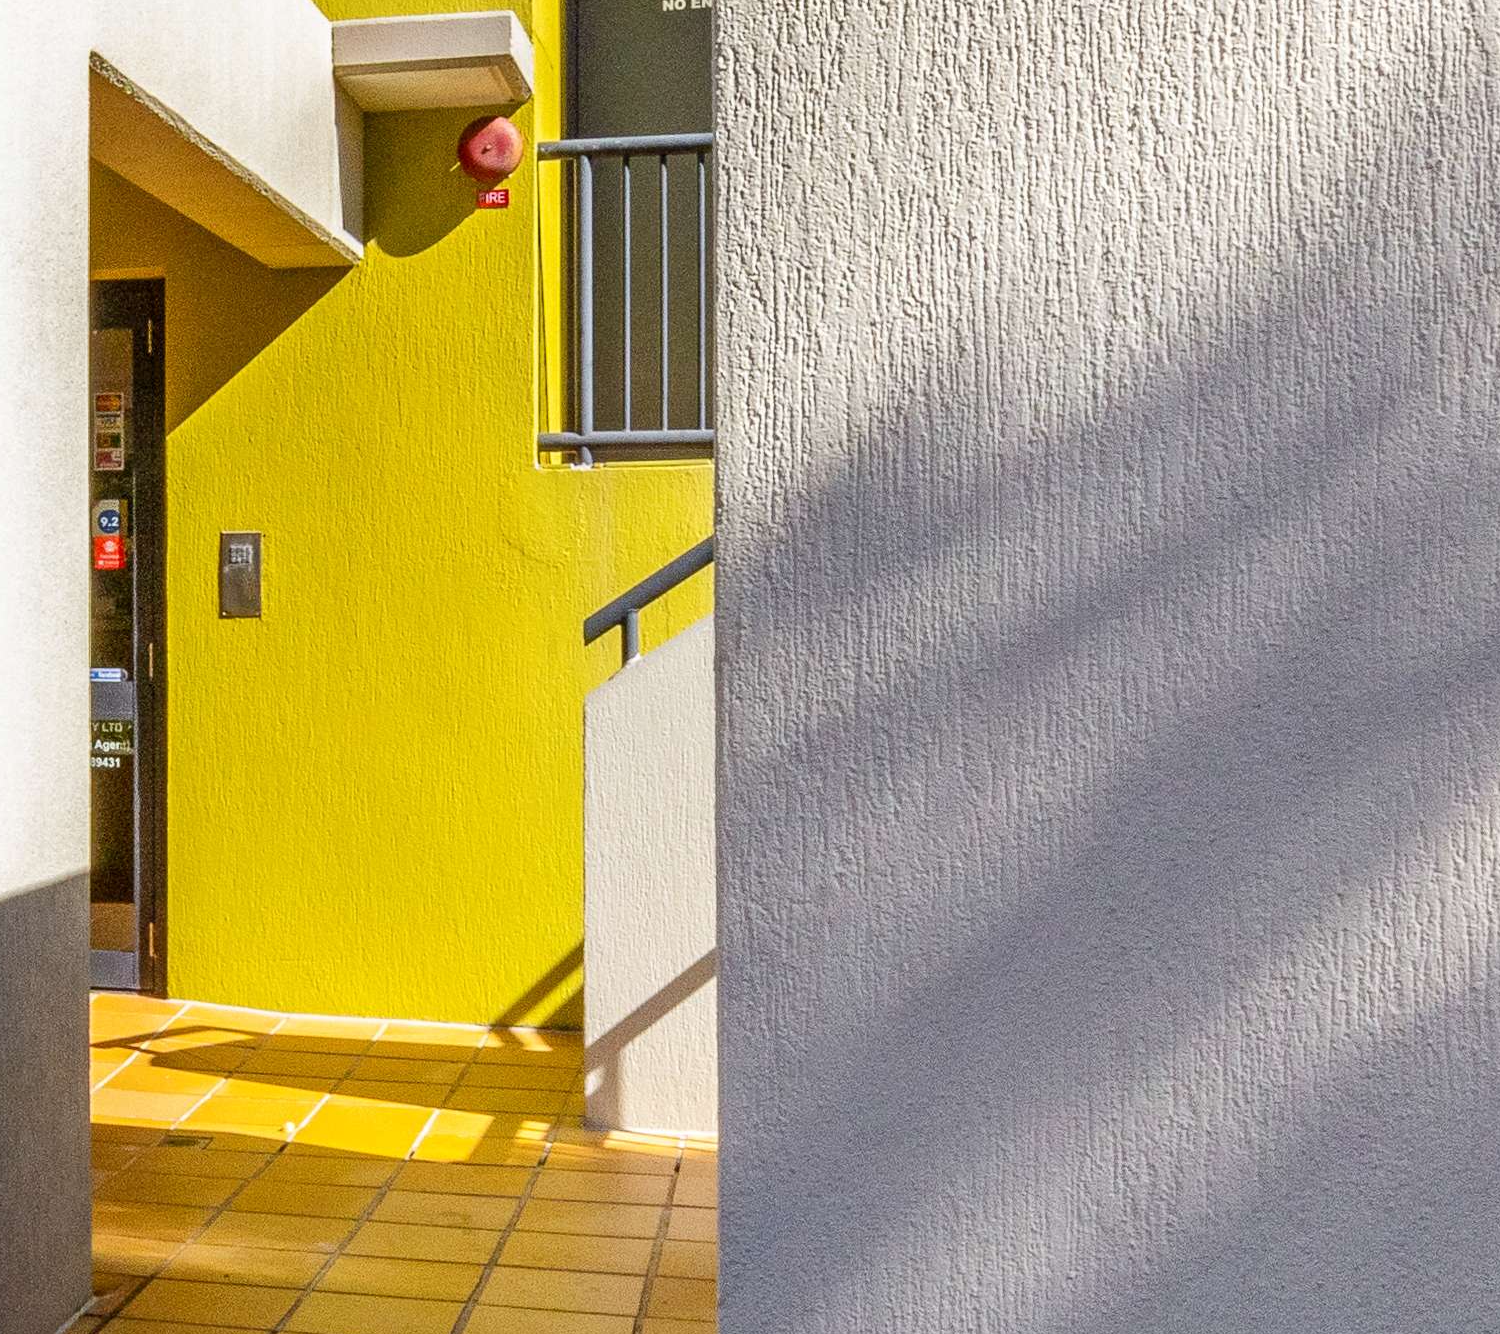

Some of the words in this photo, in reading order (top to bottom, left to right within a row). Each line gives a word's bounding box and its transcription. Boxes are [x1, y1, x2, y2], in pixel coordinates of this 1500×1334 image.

[662, 0, 686, 11] NO
[479, 191, 506, 205] FIRE
[100, 516, 120, 528] 9.2
[101, 722, 123, 732] LTD
